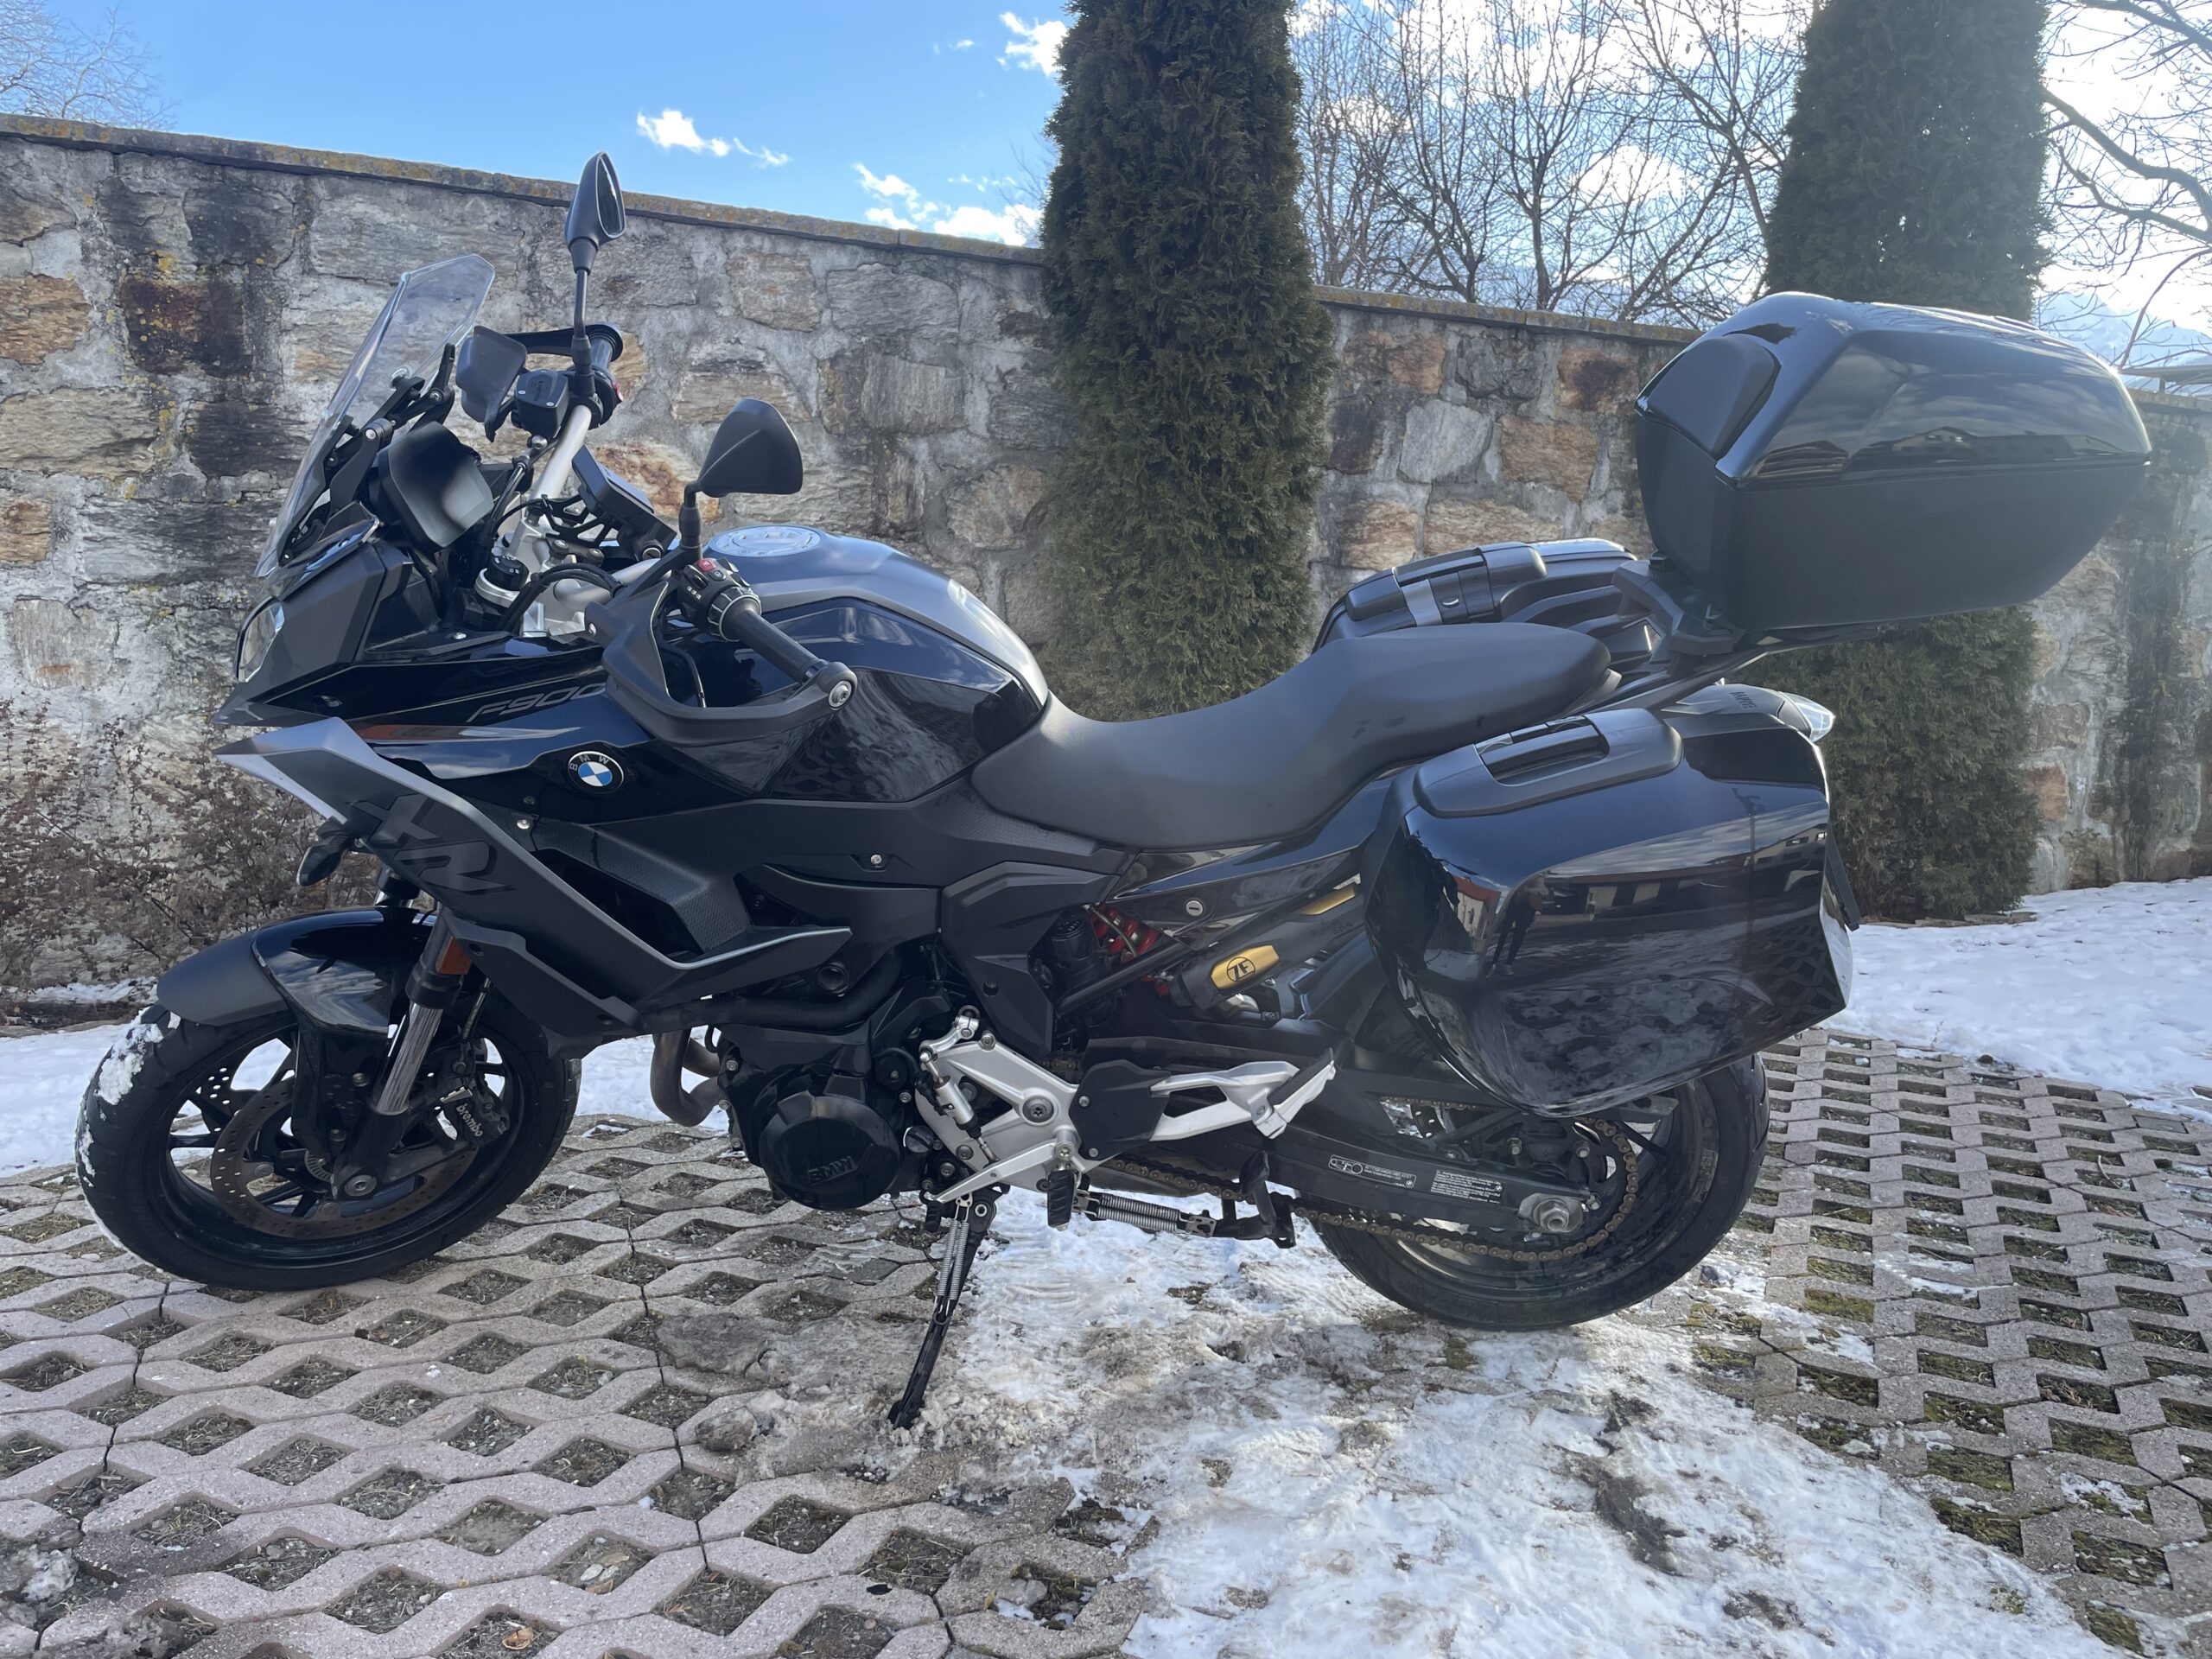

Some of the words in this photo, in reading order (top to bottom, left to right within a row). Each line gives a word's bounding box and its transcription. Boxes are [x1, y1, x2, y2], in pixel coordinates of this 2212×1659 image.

[569, 753, 609, 772] BMW
[1227, 958, 1255, 982] ZF
[456, 1103, 484, 1137] brembo
